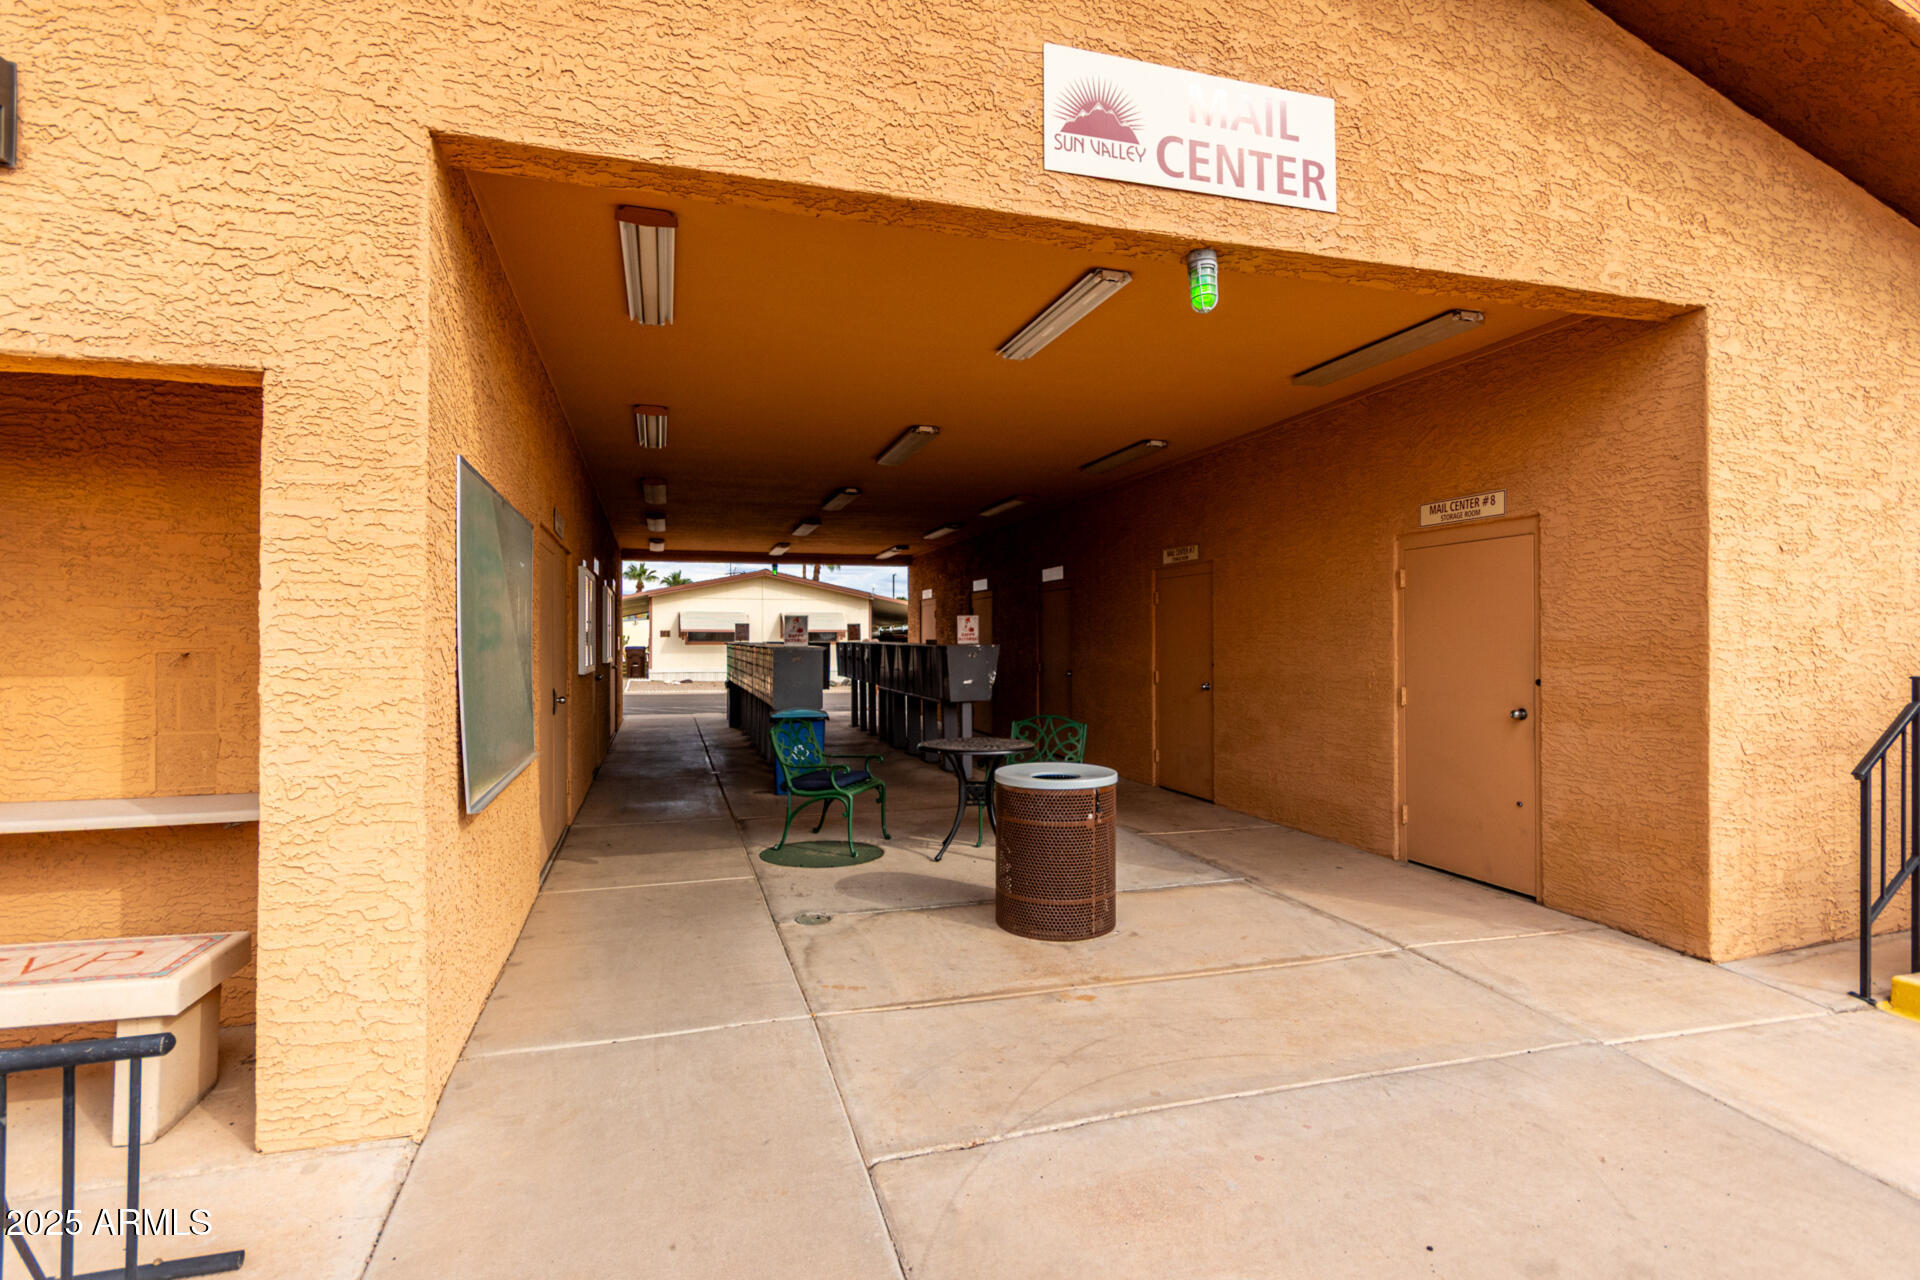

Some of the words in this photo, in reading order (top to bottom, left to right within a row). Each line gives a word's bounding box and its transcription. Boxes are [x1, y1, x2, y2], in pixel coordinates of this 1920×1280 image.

[1188, 85, 1300, 143] MAIL
[1054, 133, 1085, 154] SUN
[1090, 138, 1147, 163] VALLEY
[1156, 134, 1327, 201] CENTER
[1429, 503, 1449, 516] MAIL
[1450, 497, 1480, 512] CENTER
[1440, 511, 1463, 522] STORAGE
[1464, 509, 1481, 518] ROOM
